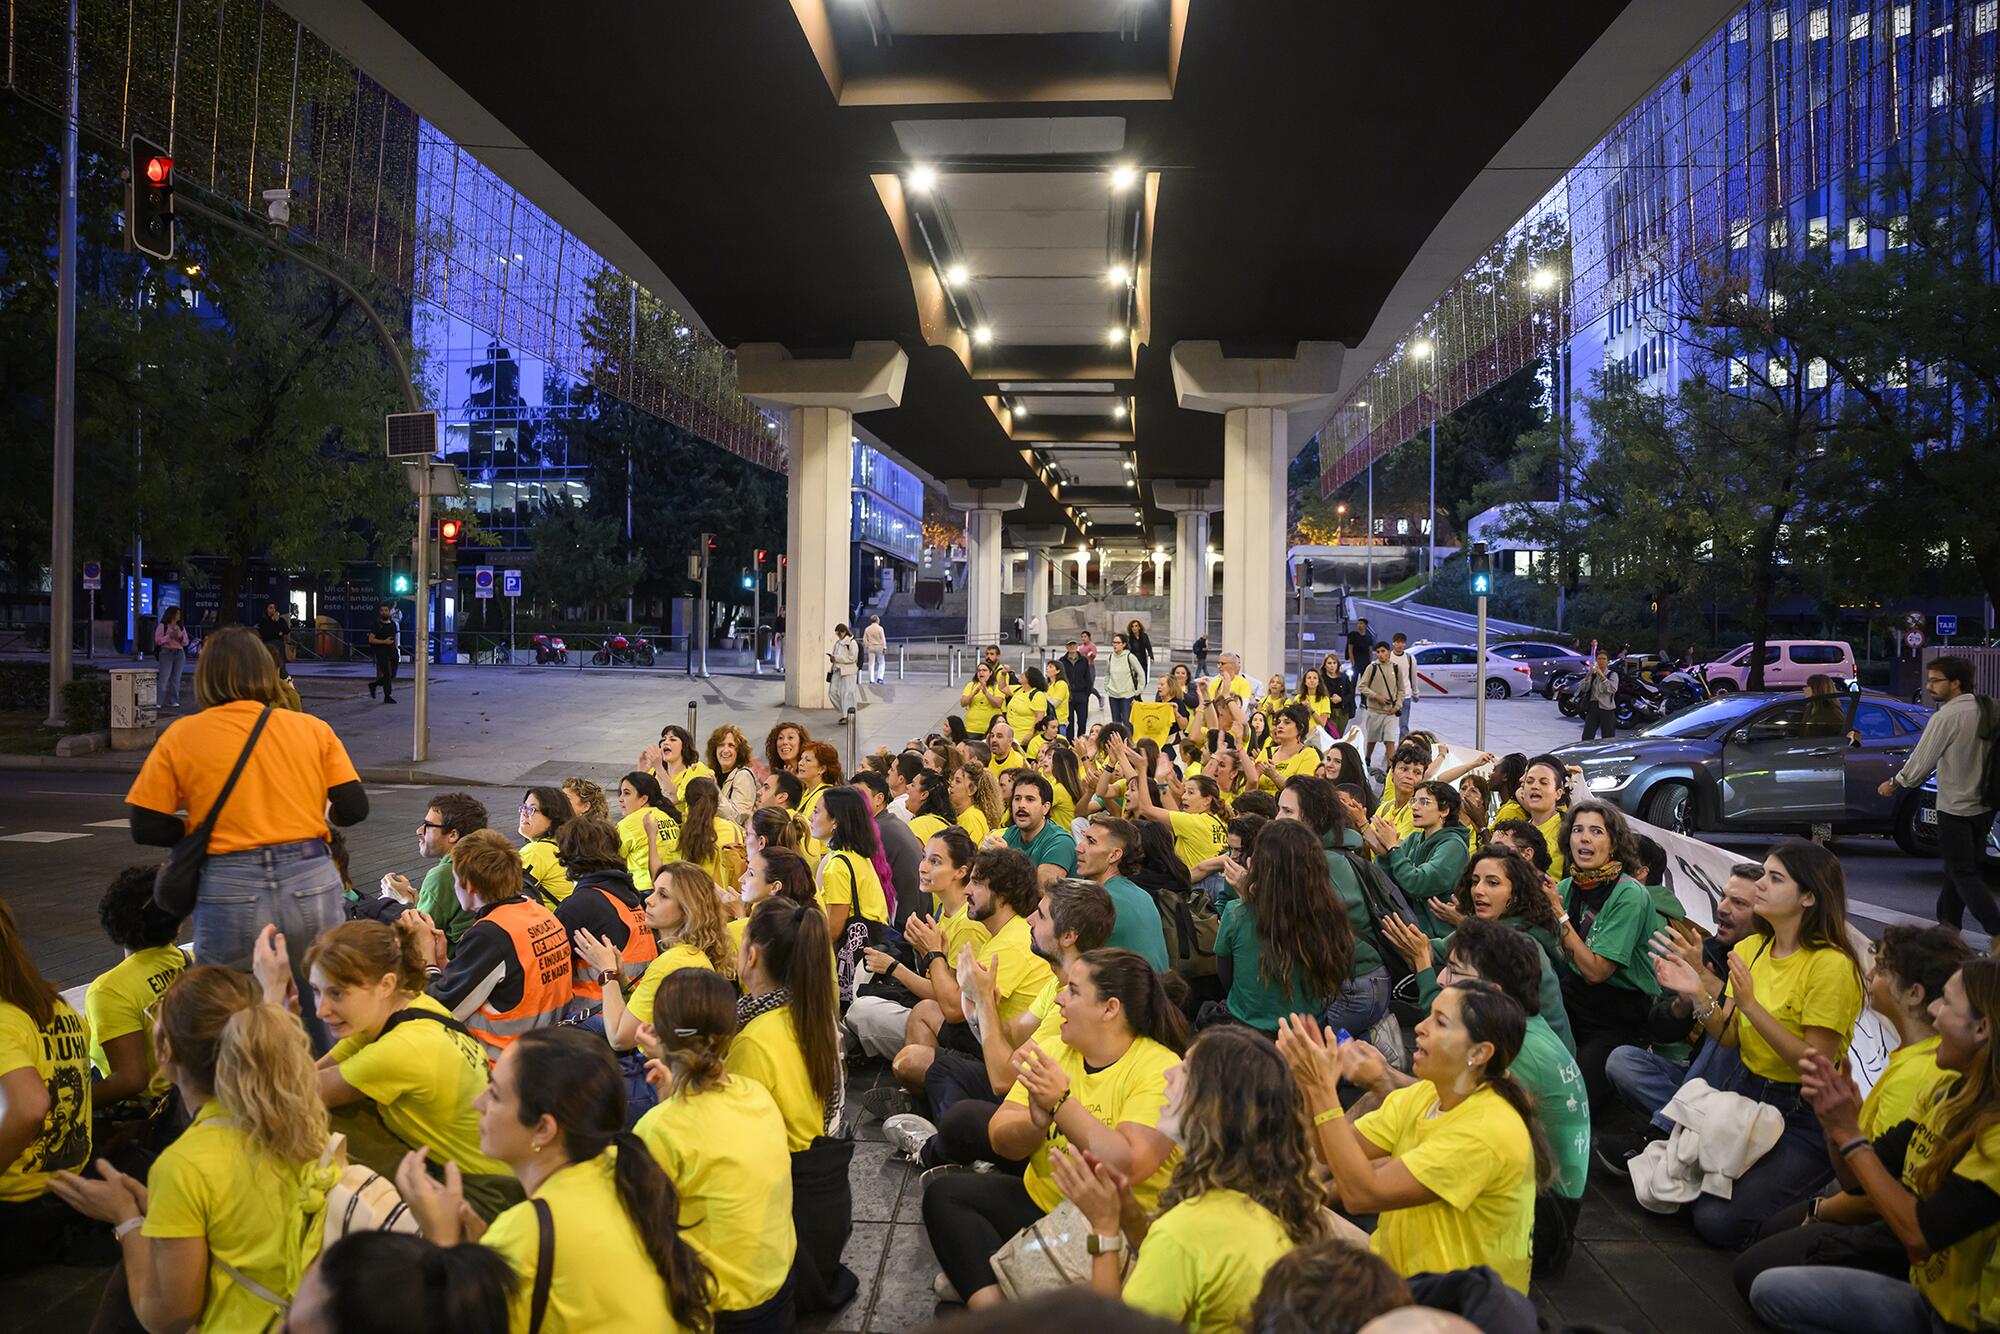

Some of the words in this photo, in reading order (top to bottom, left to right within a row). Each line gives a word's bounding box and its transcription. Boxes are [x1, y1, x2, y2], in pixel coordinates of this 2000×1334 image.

[507, 578, 516, 590] P
[660, 830, 671, 840] EN
[541, 970, 552, 985] DE
